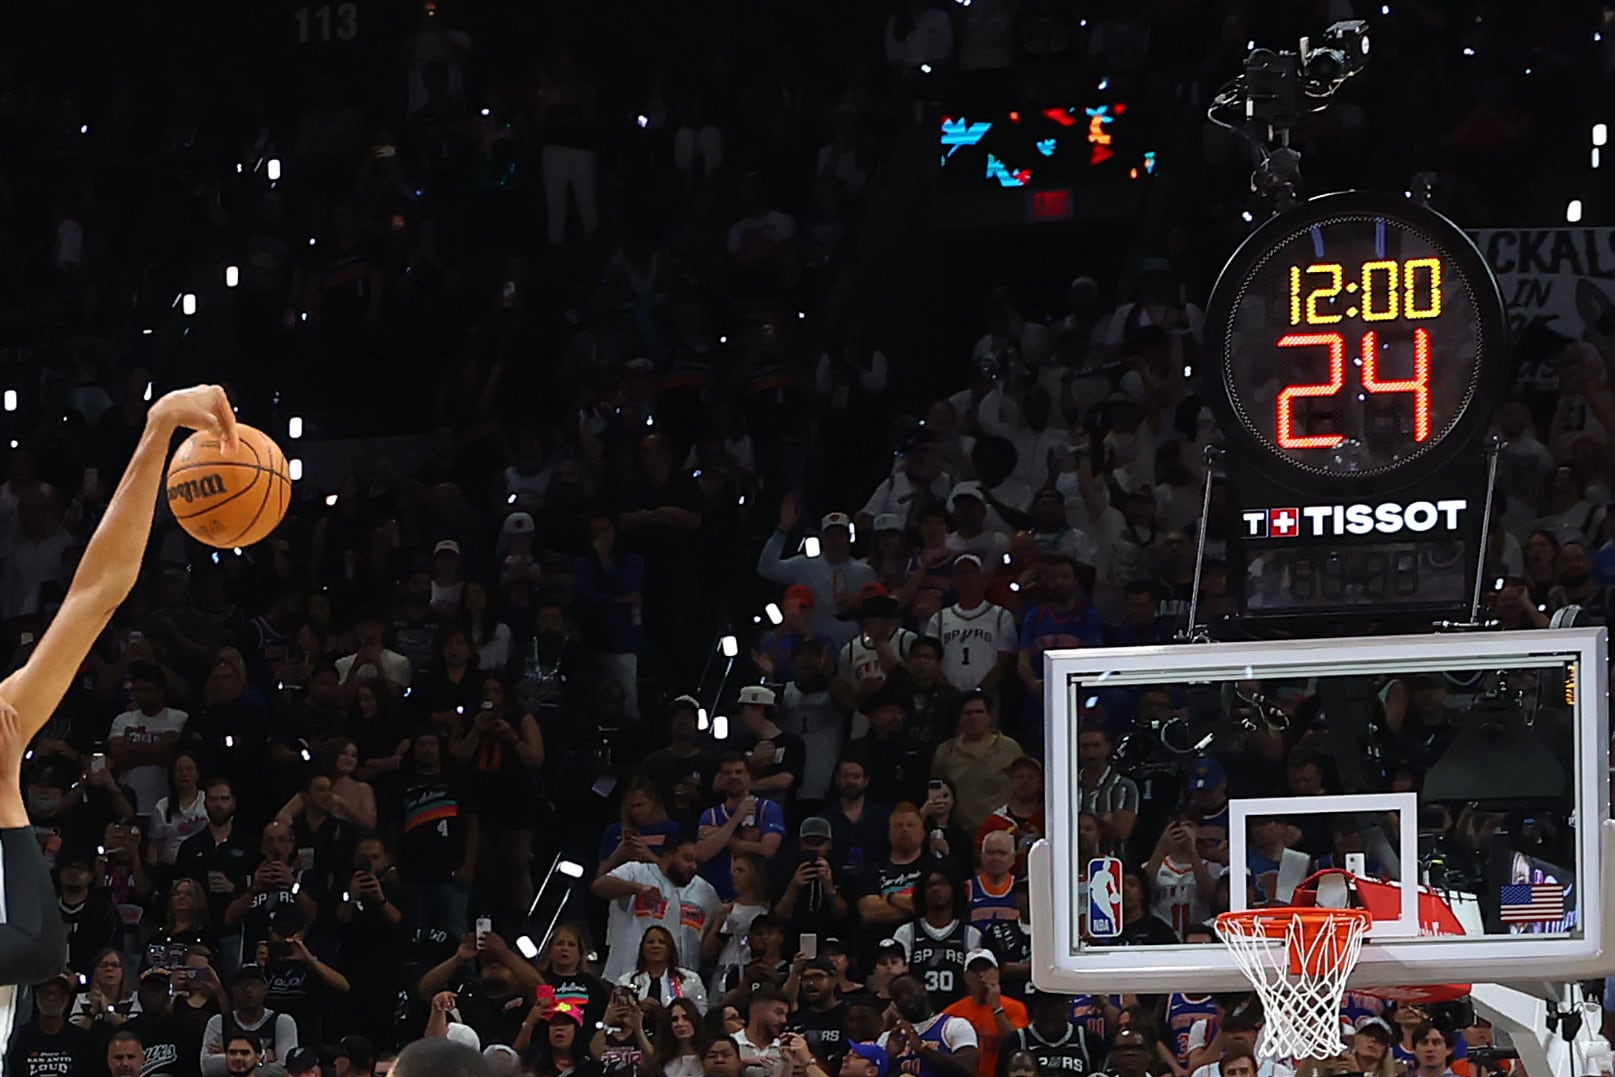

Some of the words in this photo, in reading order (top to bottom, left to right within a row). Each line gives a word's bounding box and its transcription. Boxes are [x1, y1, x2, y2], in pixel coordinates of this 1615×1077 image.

[295, 4, 358, 43] 113
[1470, 231, 1615, 278] CKAL
[1290, 257, 1443, 325] 12:00
[1276, 327, 1431, 449] 24
[1304, 499, 1467, 537] TISSOT
[961, 648, 970, 665] 1
[436, 819, 448, 837] 4
[914, 948, 965, 964] SPRS
[924, 970, 954, 992] 30
[29, 1063, 69, 1077] LOUD
